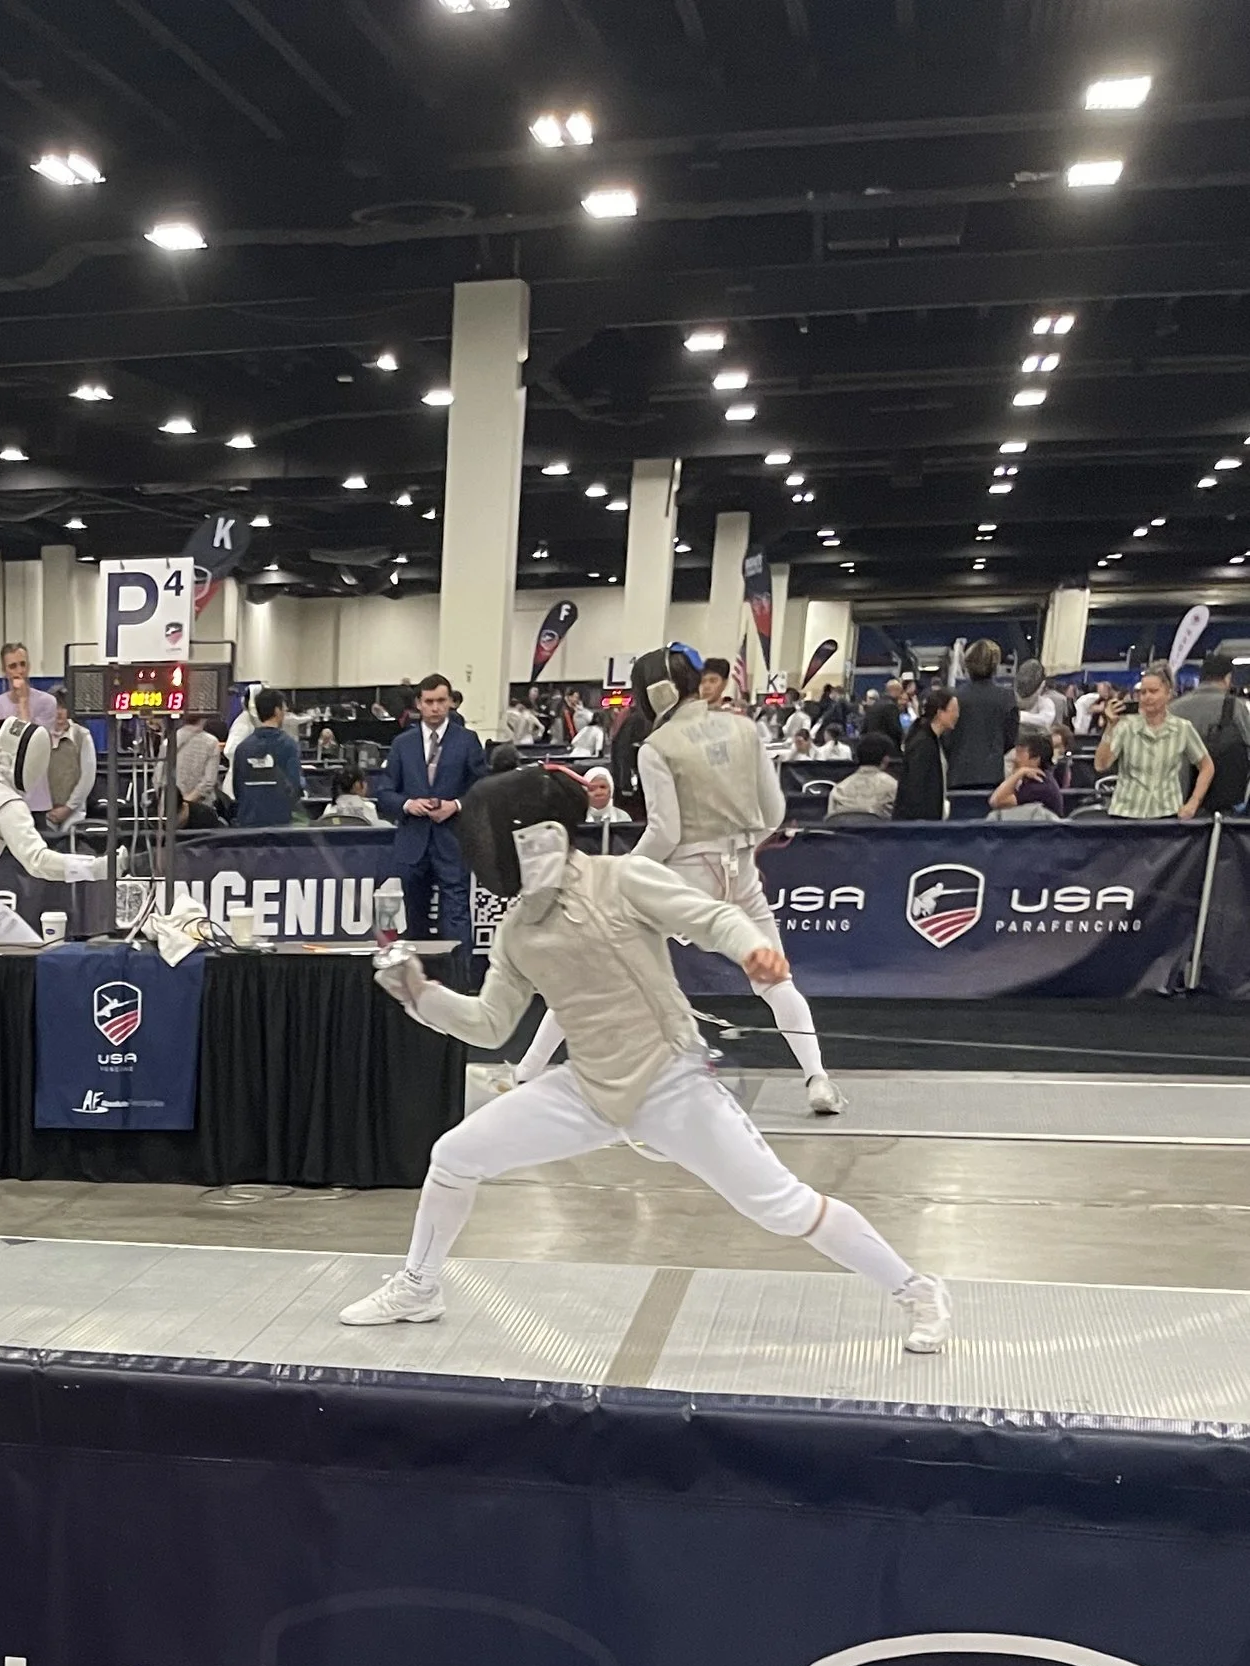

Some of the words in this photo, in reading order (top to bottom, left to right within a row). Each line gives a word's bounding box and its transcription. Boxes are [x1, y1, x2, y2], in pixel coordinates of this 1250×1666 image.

[213, 517, 235, 550] K
[105, 571, 159, 658] P
[164, 570, 184, 597] 4
[607, 657, 626, 687] L
[767, 673, 779, 692] K
[115, 692, 130, 710] 13
[167, 692, 184, 710] 13
[1010, 886, 1135, 913] USA
[995, 920, 1142, 933] PARAFENCING
[97, 1053, 138, 1065] USA
